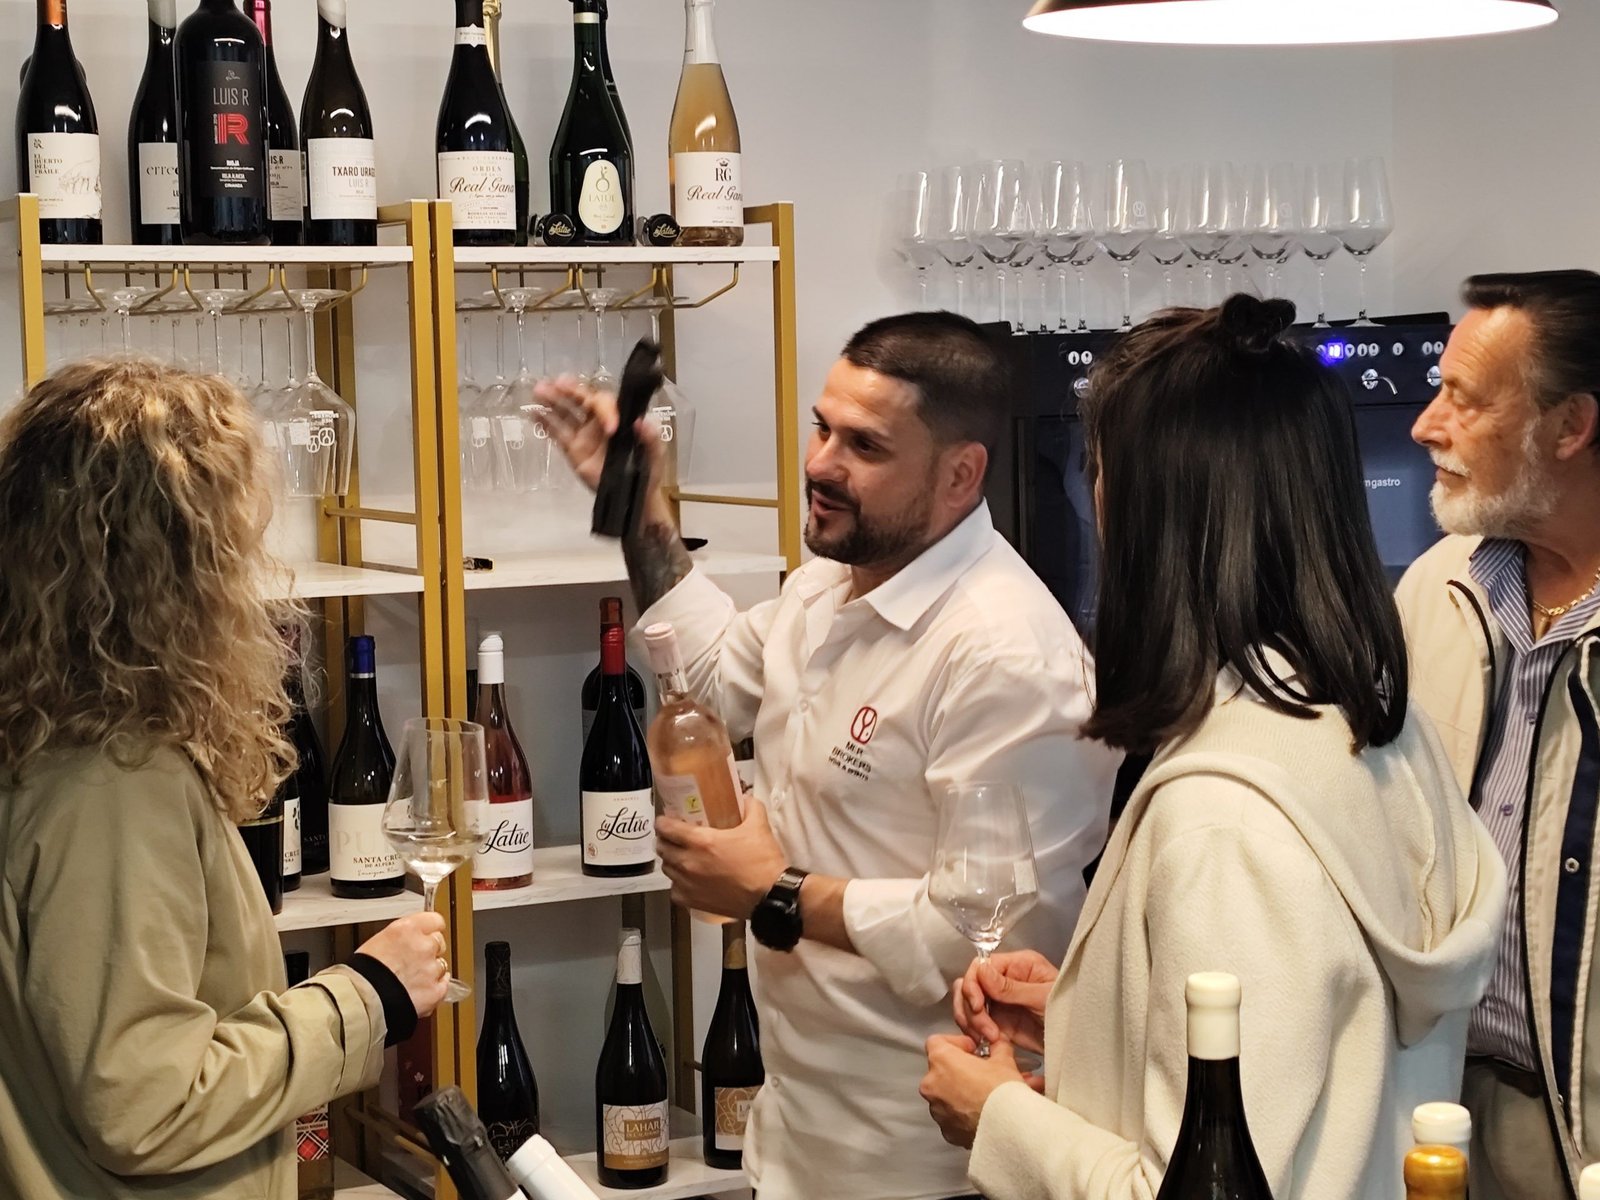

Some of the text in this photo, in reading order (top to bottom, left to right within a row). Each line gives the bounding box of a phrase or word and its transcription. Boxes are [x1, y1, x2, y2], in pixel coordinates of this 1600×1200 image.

[213, 87, 250, 106] LUIS R
[332, 166, 359, 177] TXARO
[715, 167, 732, 182] RG
[449, 176, 488, 194] Real
[686, 184, 724, 202] Real
[353, 856, 382, 864] SANTA
[626, 1120, 660, 1133] LAHAR
